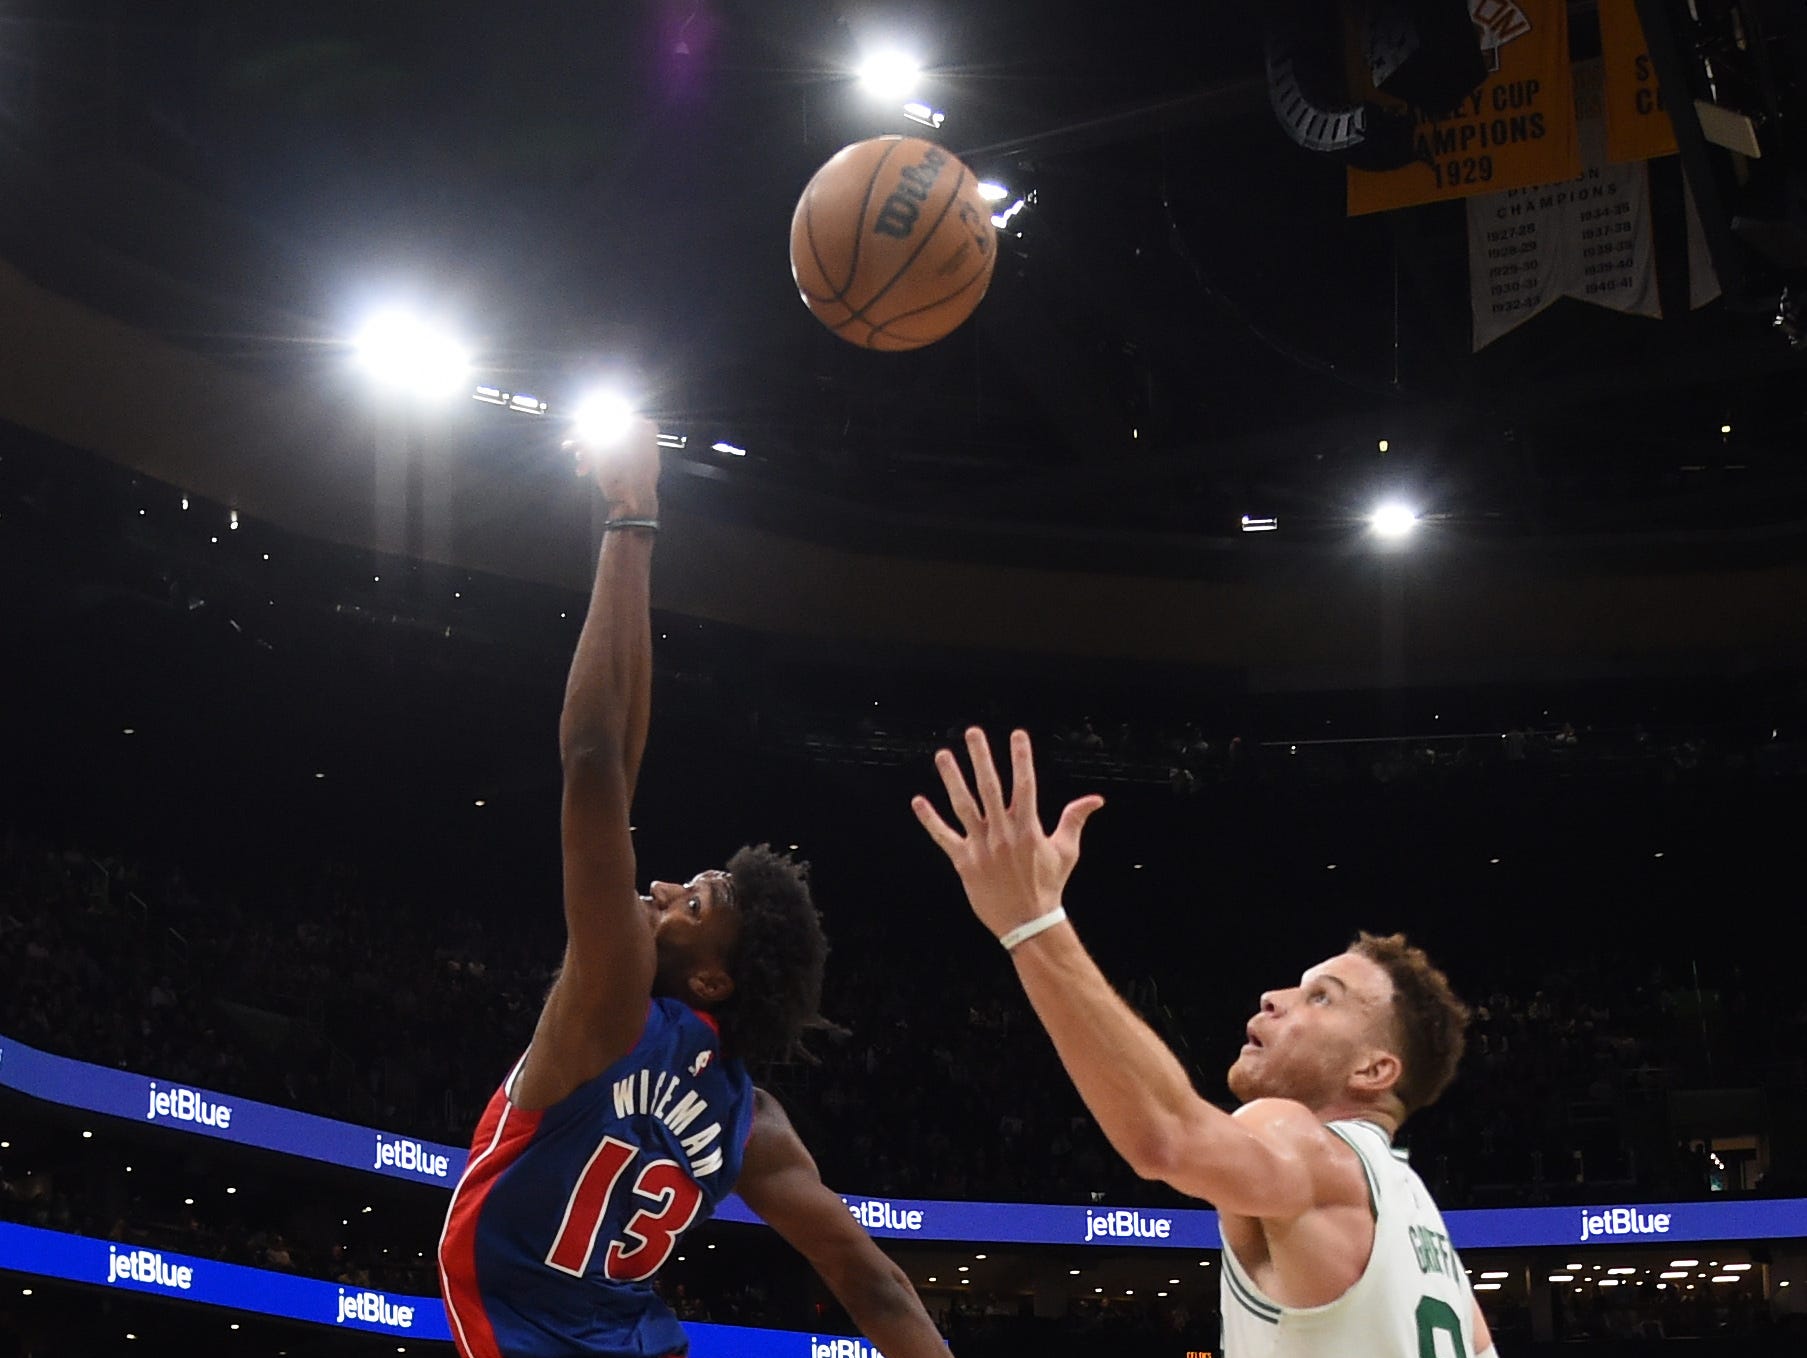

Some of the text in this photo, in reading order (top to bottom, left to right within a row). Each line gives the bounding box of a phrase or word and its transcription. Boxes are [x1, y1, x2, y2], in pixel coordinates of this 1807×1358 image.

[1493, 79, 1540, 111] CUP
[1418, 112, 1546, 160] AMPIONS
[1436, 156, 1494, 189] 1929
[1496, 183, 1617, 220] CHAMPIONS
[147, 1082, 232, 1129] jetBlue
[374, 1135, 449, 1177] jetBlue
[545, 1135, 703, 1282] 13
[842, 1198, 924, 1230] etBlue
[1084, 1209, 1172, 1242] jetBlue
[1580, 1208, 1671, 1241] jetBlue
[107, 1246, 193, 1289] jetBlue
[337, 1288, 415, 1328] jetBlue
